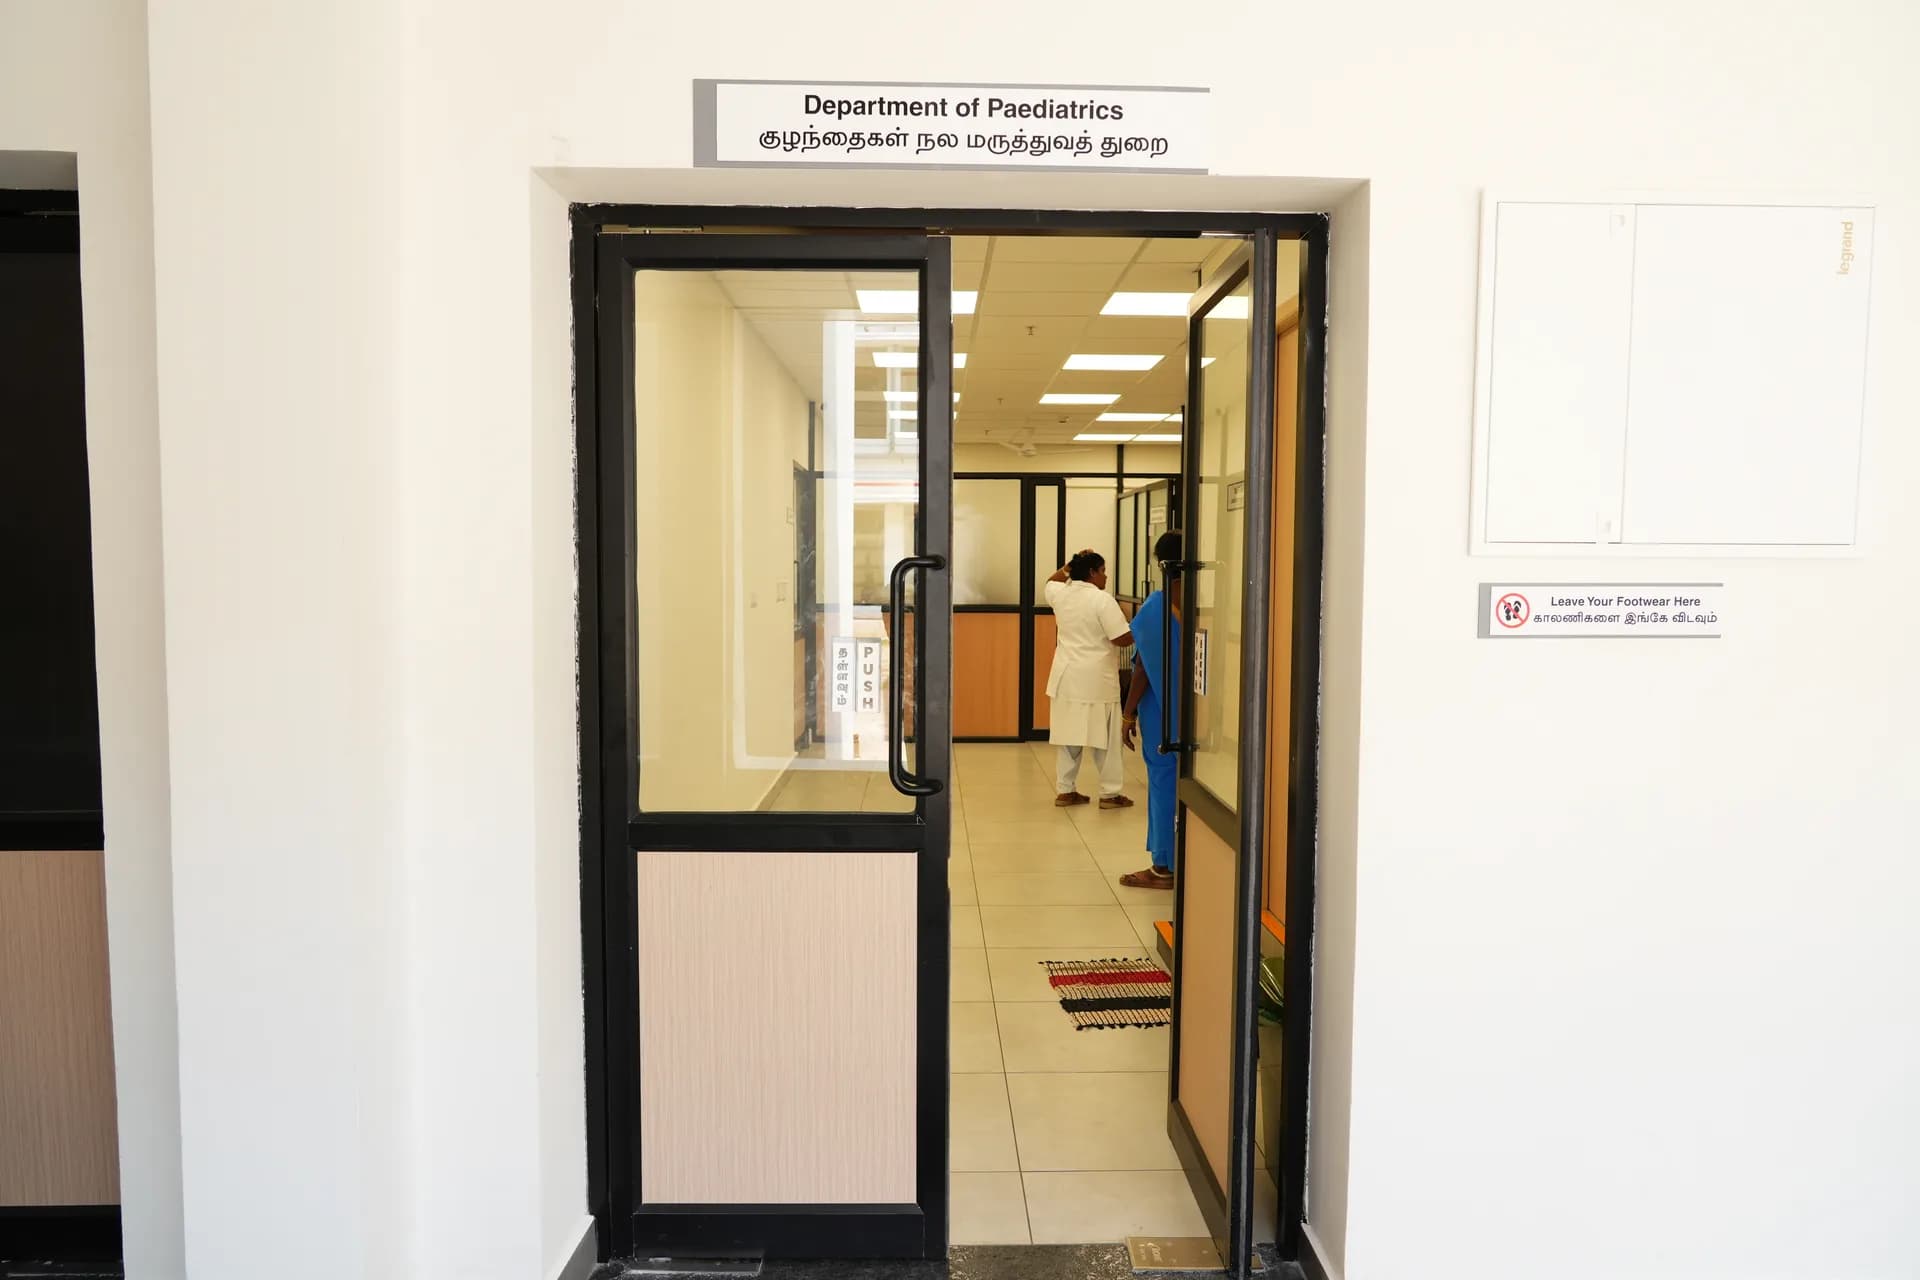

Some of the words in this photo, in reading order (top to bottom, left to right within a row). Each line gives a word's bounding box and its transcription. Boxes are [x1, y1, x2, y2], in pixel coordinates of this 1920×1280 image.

[804, 94, 948, 121] Department
[955, 97, 980, 118] of
[988, 97, 1124, 121] Paediatrics
[758, 124, 910, 154] குழந்தைகள்
[915, 132, 959, 155] நல
[967, 128, 1093, 158] மருத்துவத்
[1099, 136, 1169, 159] துறை
[1837, 220, 1855, 275] legrand
[1550, 596, 1585, 607] Leave
[1587, 596, 1614, 607] Your
[1616, 596, 1671, 607] Footwear
[1673, 596, 1701, 607] Here
[1533, 611, 1621, 624] காலணிகளை
[1623, 611, 1669, 626] இங்கே
[1672, 611, 1718, 626] விடவும்
[862, 646, 874, 710] PUSH
